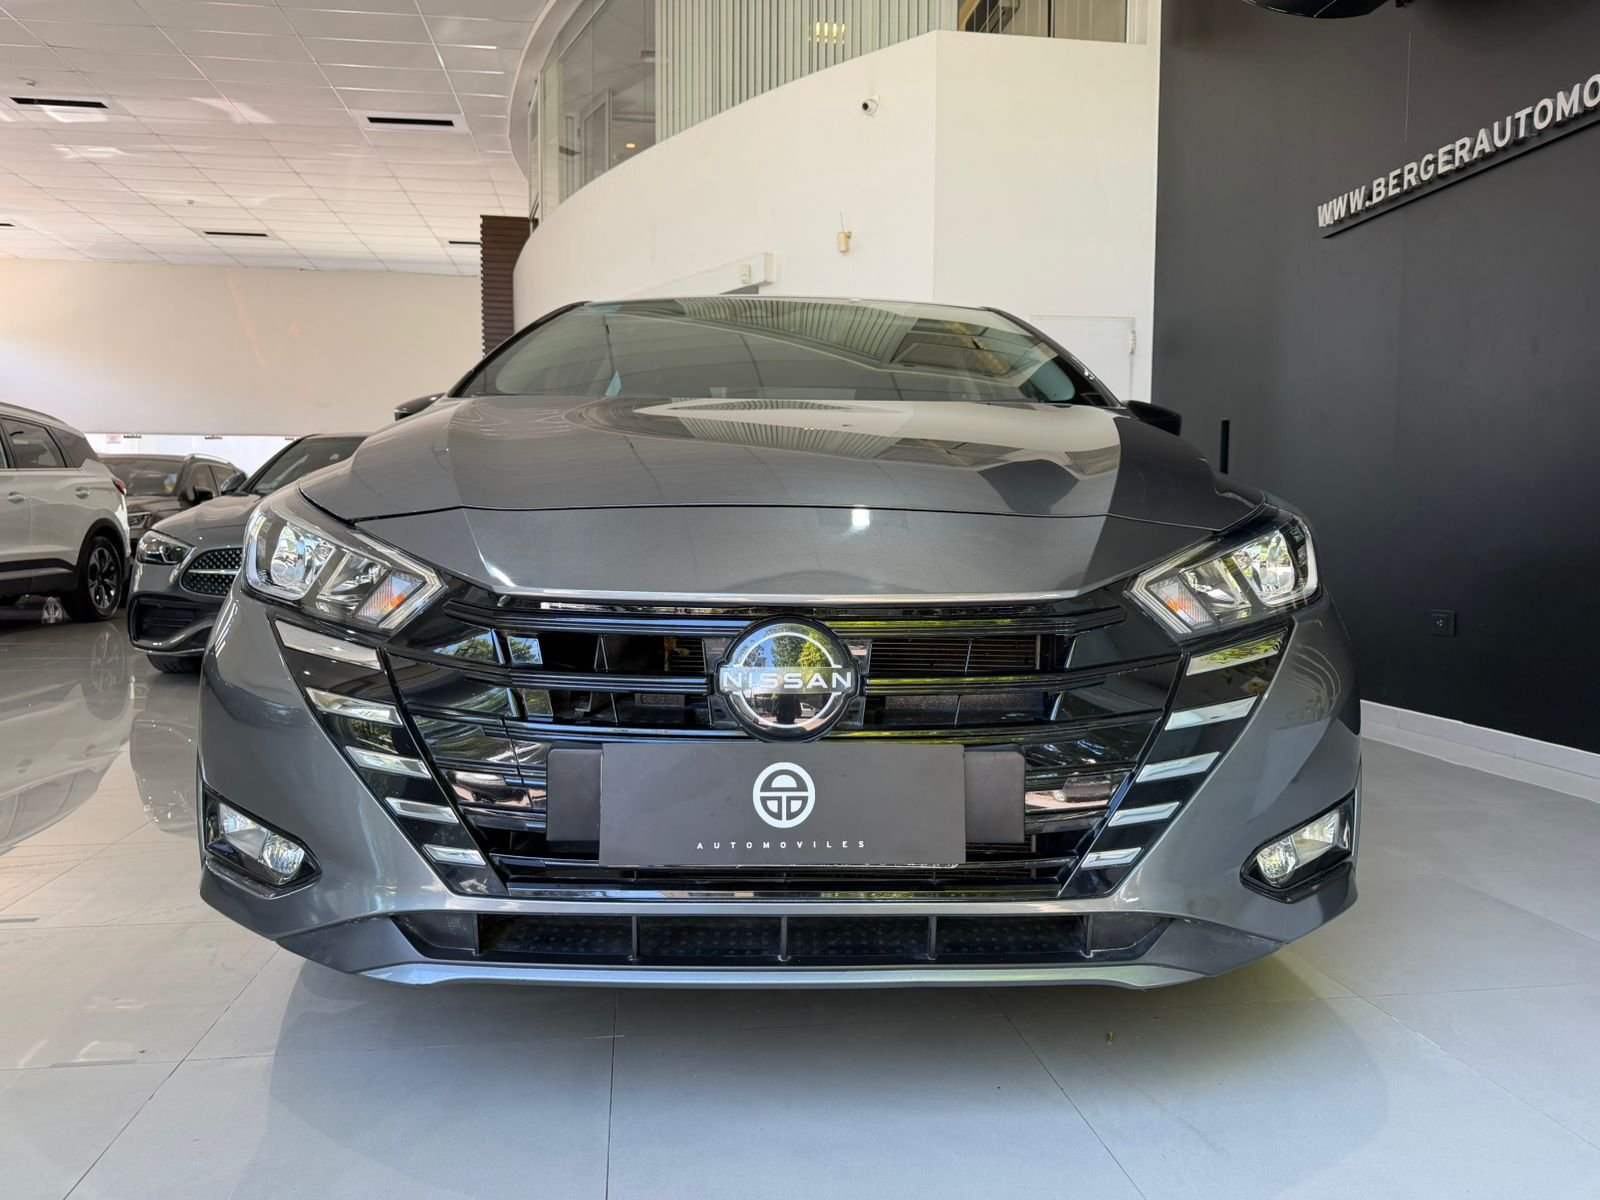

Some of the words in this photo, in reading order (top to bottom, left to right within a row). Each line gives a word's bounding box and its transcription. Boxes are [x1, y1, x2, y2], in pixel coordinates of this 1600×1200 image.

[1317, 73, 1600, 227] WWW.BERGERAUTOMO
[722, 671, 852, 689] NISSAN
[697, 838, 865, 850] AUTOMOVILES
